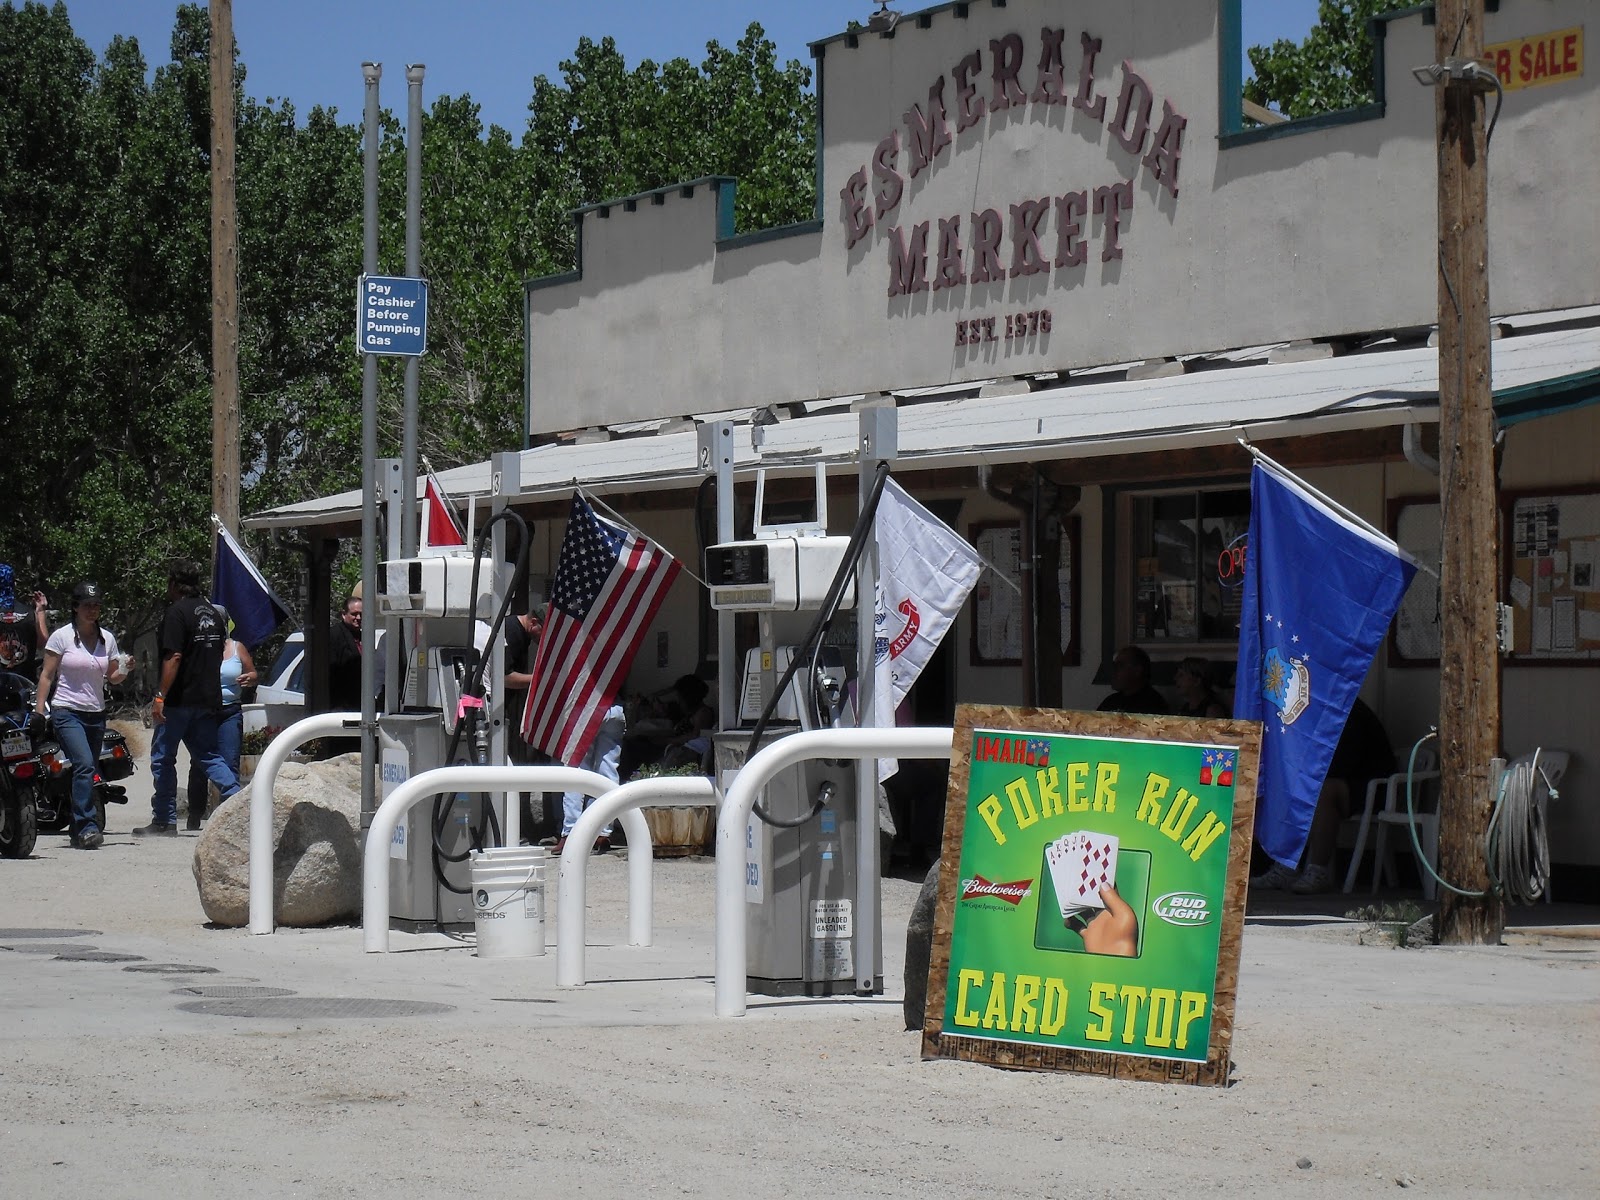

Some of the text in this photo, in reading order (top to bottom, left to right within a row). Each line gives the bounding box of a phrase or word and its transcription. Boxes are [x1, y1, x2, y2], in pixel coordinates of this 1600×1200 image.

[1520, 34, 1577, 83] SALE
[840, 27, 1187, 250] ESMERALDA
[888, 180, 1133, 298] MARKET
[368, 282, 391, 295] Pay
[368, 296, 416, 308] Cashier
[367, 308, 409, 320] Before
[367, 321, 421, 336] Pumping
[955, 317, 999, 346] EST.
[366, 335, 391, 345] Gas
[702, 446, 709, 469] 2
[494, 474, 500, 493] 3
[1218, 546, 1248, 578] OPE
[893, 620, 918, 654] ARMY
[976, 737, 1027, 764] IMAH
[976, 762, 1227, 863] POKER RUN
[962, 879, 1032, 898] Budweiser
[1170, 897, 1207, 909] BUD
[815, 916, 848, 924] UNLEADED
[1160, 907, 1210, 920] LIGHT
[816, 924, 847, 932] GASOLINE
[954, 968, 1208, 1050] CARD STOP
